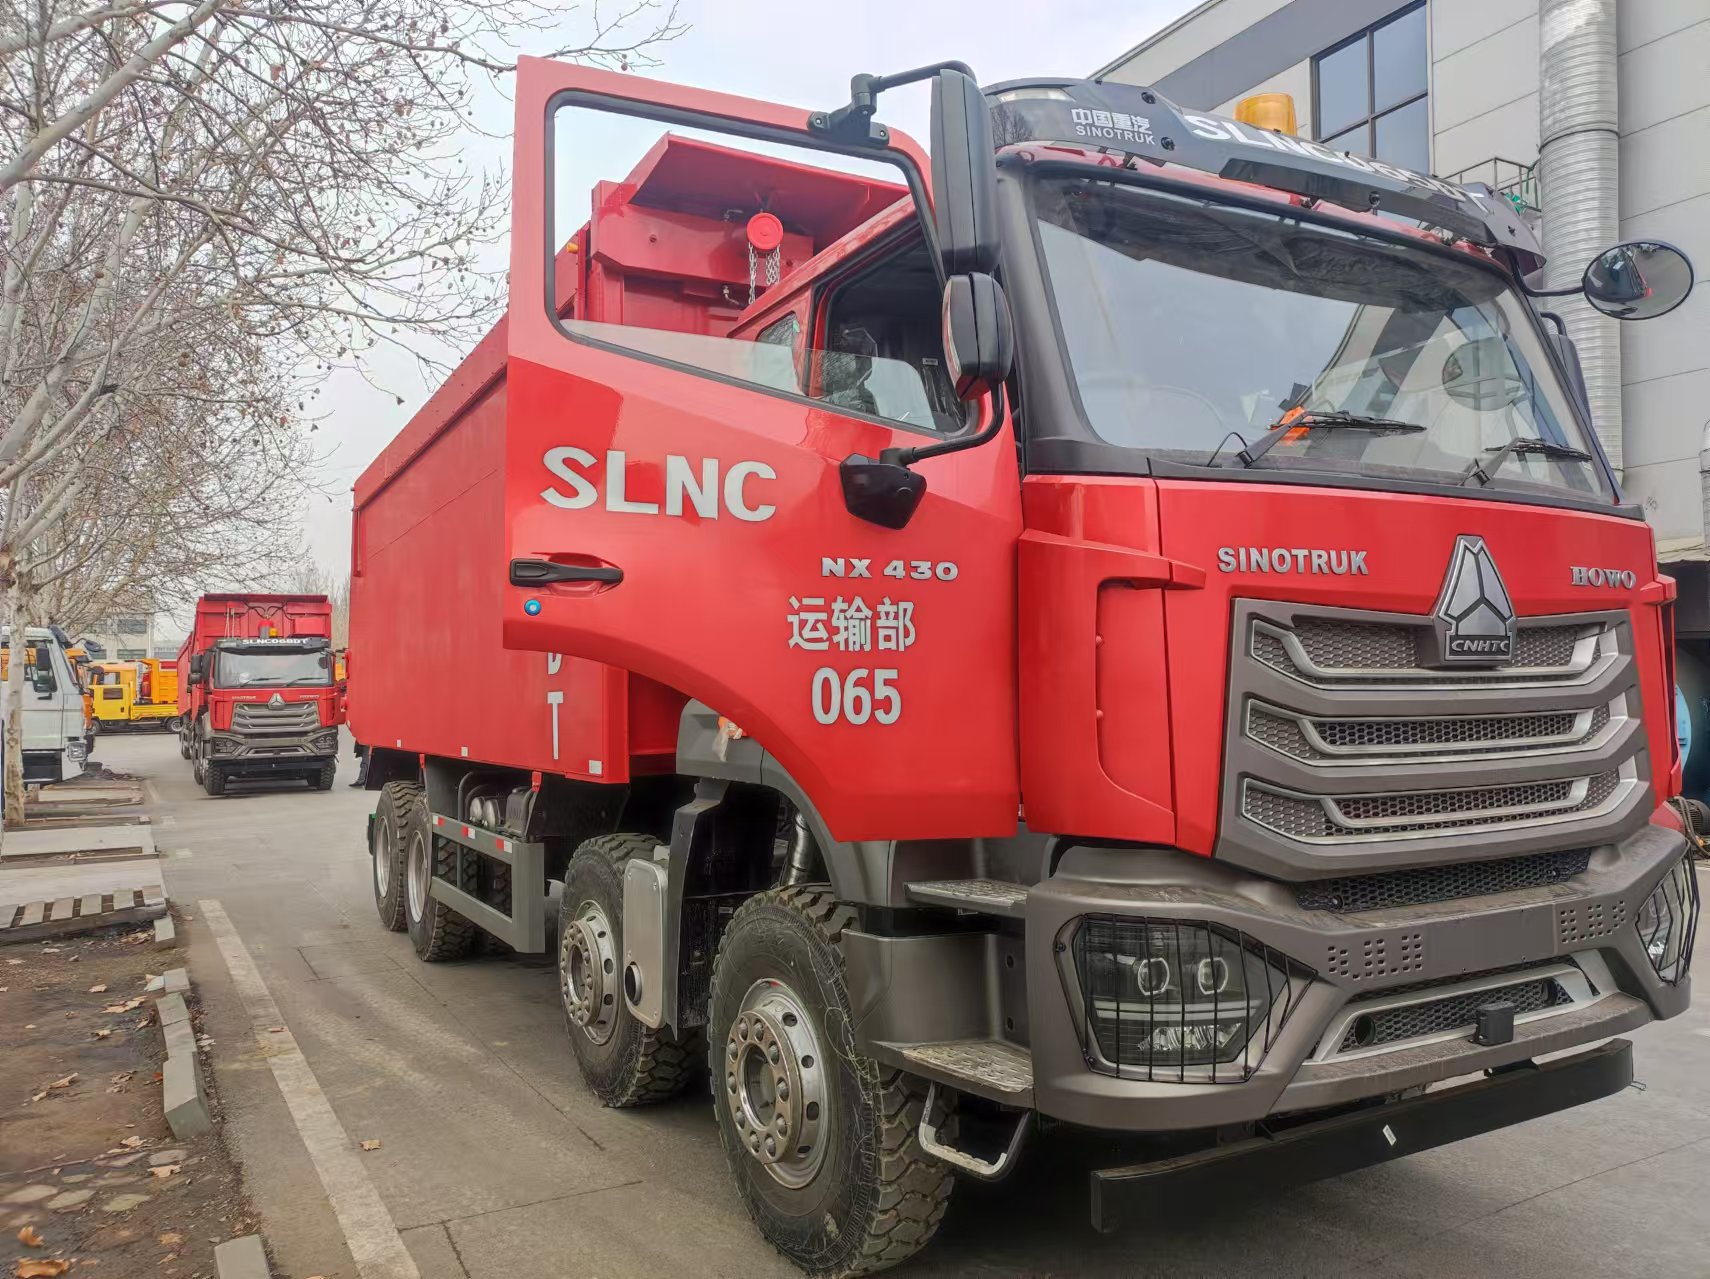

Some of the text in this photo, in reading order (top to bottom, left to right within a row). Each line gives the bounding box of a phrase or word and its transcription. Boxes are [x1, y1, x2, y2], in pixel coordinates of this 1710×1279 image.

[1071, 108, 1153, 135] 中国重汽
[1075, 125, 1156, 145] SINOTRUK
[540, 446, 777, 522] SLNC
[820, 557, 959, 581] NX 430
[1217, 547, 1369, 576] SINOTRUK
[1570, 566, 1637, 590] HOWO
[787, 596, 917, 653] 运输部
[1451, 639, 1509, 652] CNHTC
[811, 667, 902, 725] 065
